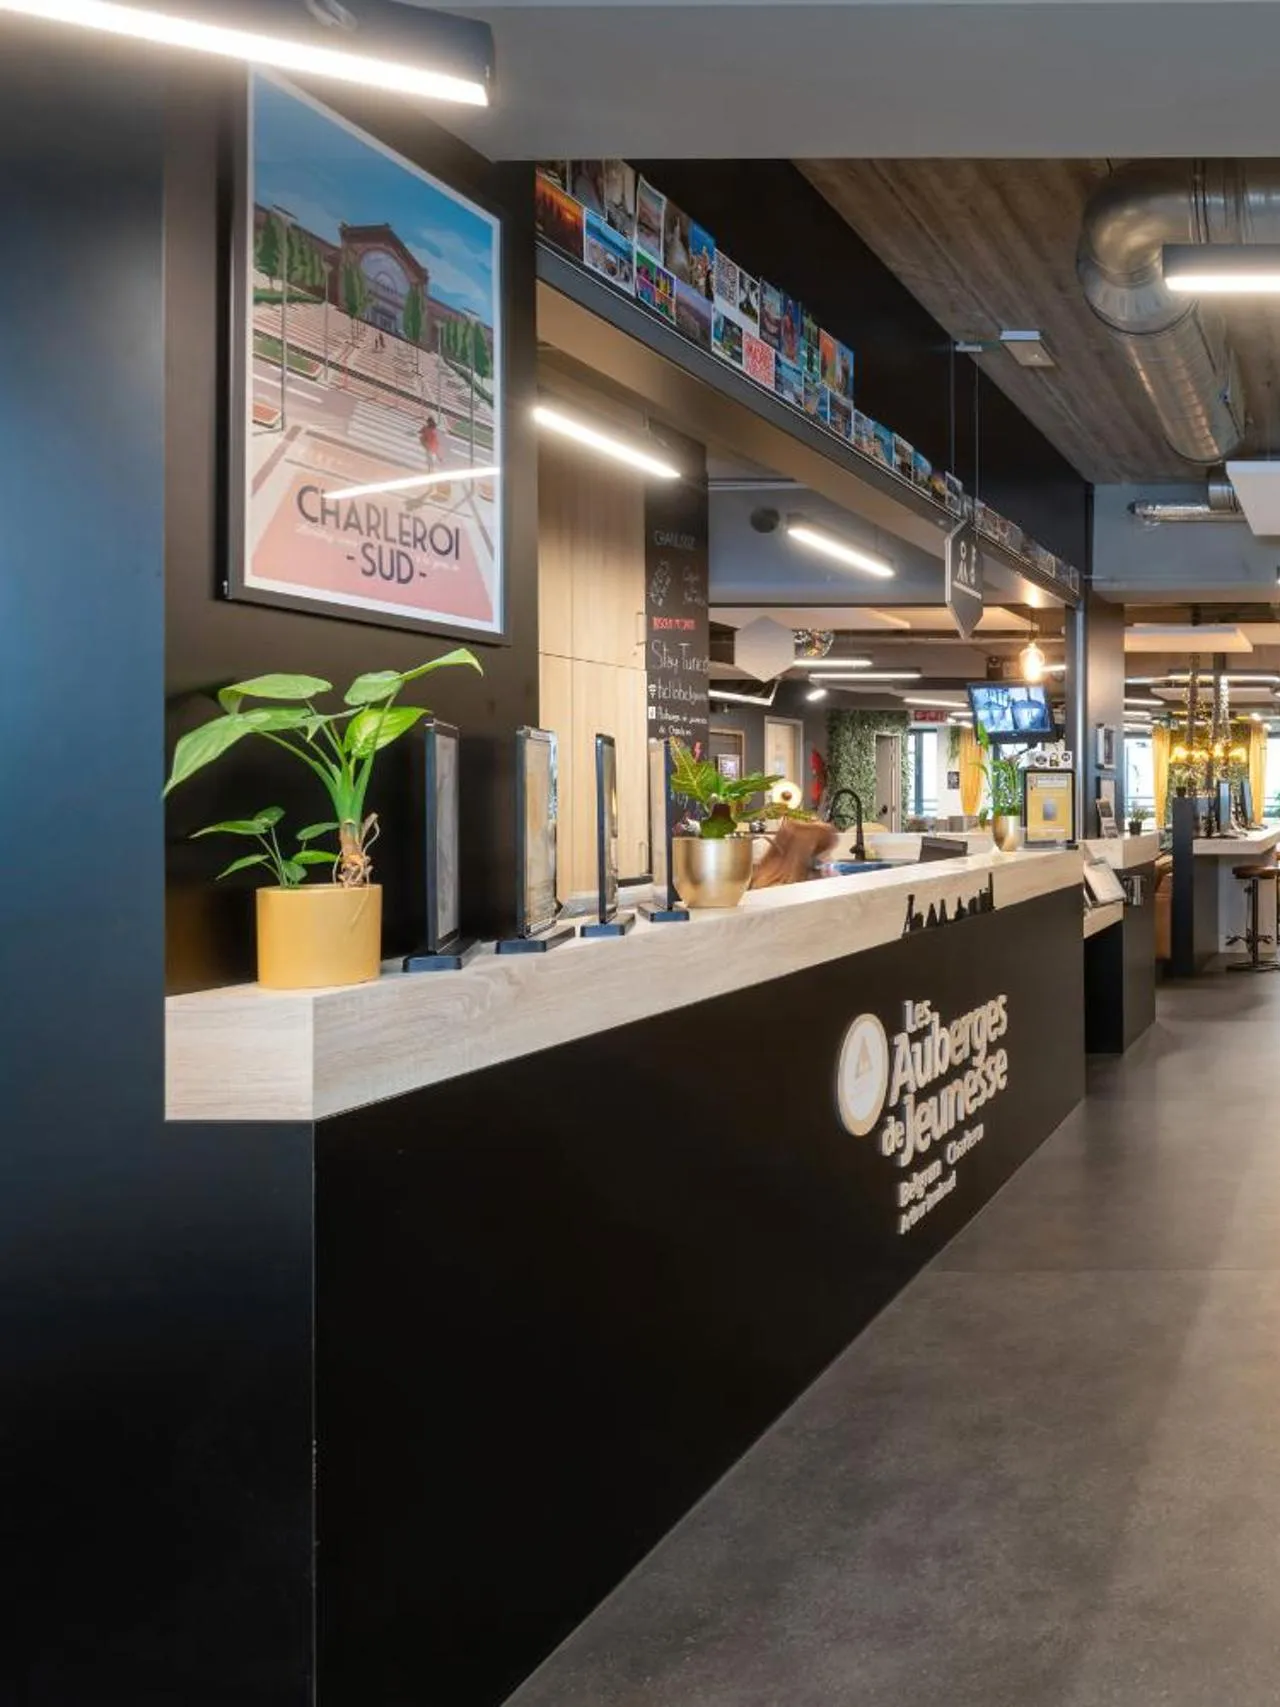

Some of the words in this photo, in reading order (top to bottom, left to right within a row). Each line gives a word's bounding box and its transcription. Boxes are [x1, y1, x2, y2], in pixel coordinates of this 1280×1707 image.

[297, 484, 460, 560] CHARLEROI
[651, 639, 679, 675] Stay
[889, 994, 1008, 1107] Auberges
[903, 1000, 932, 1033] Les
[881, 1116, 905, 1156] de
[899, 1048, 1008, 1168] Jeunesse
